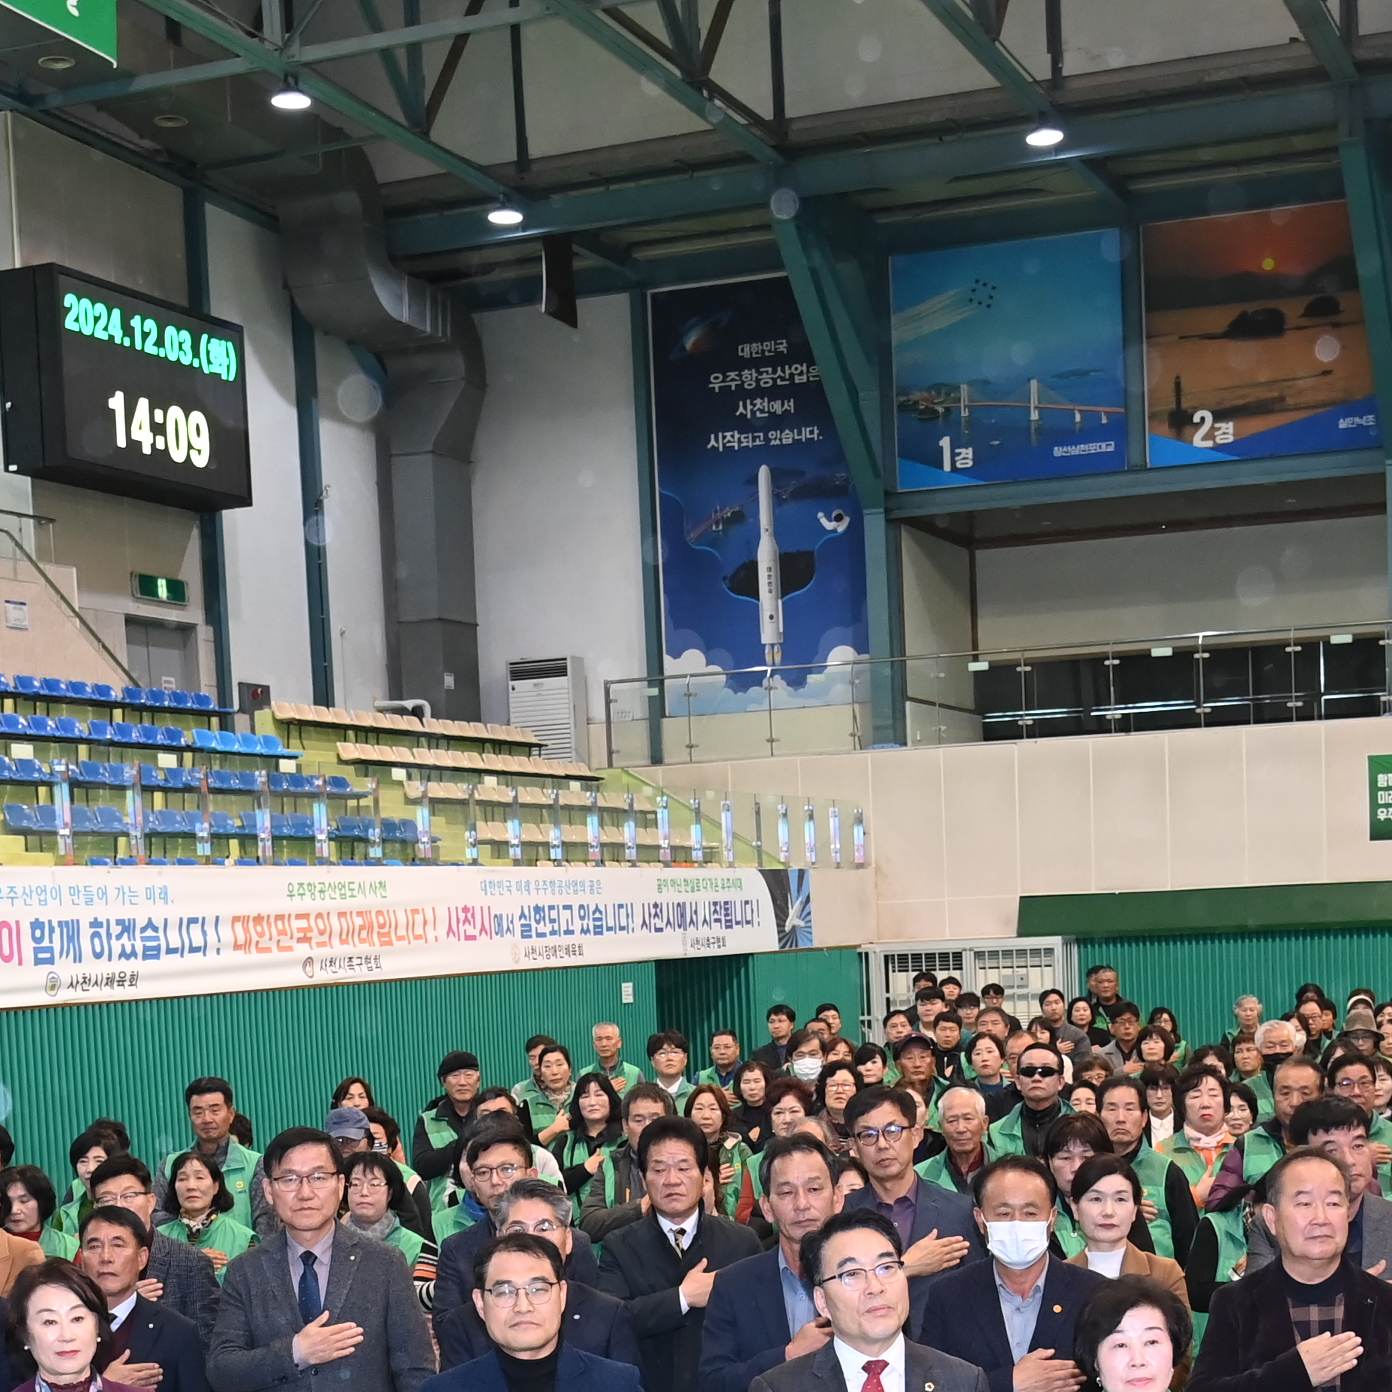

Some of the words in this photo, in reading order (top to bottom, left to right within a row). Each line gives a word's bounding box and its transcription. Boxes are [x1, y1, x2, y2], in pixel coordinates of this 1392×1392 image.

[63, 292, 237, 382] 2024.12.03.(화)
[738, 339, 788, 359] 대한민국
[708, 363, 821, 393] 우주항공산업은
[735, 397, 795, 419] 사천에서
[108, 390, 210, 469] 14:09
[707, 430, 765, 452] 시작되고
[768, 425, 823, 446] 있습니다.
[1192, 409, 1235, 448] 2경
[938, 435, 974, 473] 1경
[68, 884, 109, 907] 만들어
[114, 885, 140, 907] 가는
[286, 880, 367, 902] 우주항공산업도시
[368, 880, 388, 900] 사천
[480, 878, 513, 897] 대한민국
[515, 879, 532, 896] 미래
[533, 879, 586, 896] 우주항공산업의
[588, 878, 603, 895] 꿈은
[446, 904, 515, 942] 사천시에서
[518, 903, 576, 940] 실현되고
[578, 902, 635, 938] 있습니다!
[640, 900, 699, 934] 사천시에서
[29, 917, 83, 967] 함께
[230, 911, 334, 955] 대한민국의
[319, 954, 383, 975] 사천시족구협회
[523, 942, 585, 962] 사천시장애인체육회
[67, 969, 140, 993] 사천시체육회
